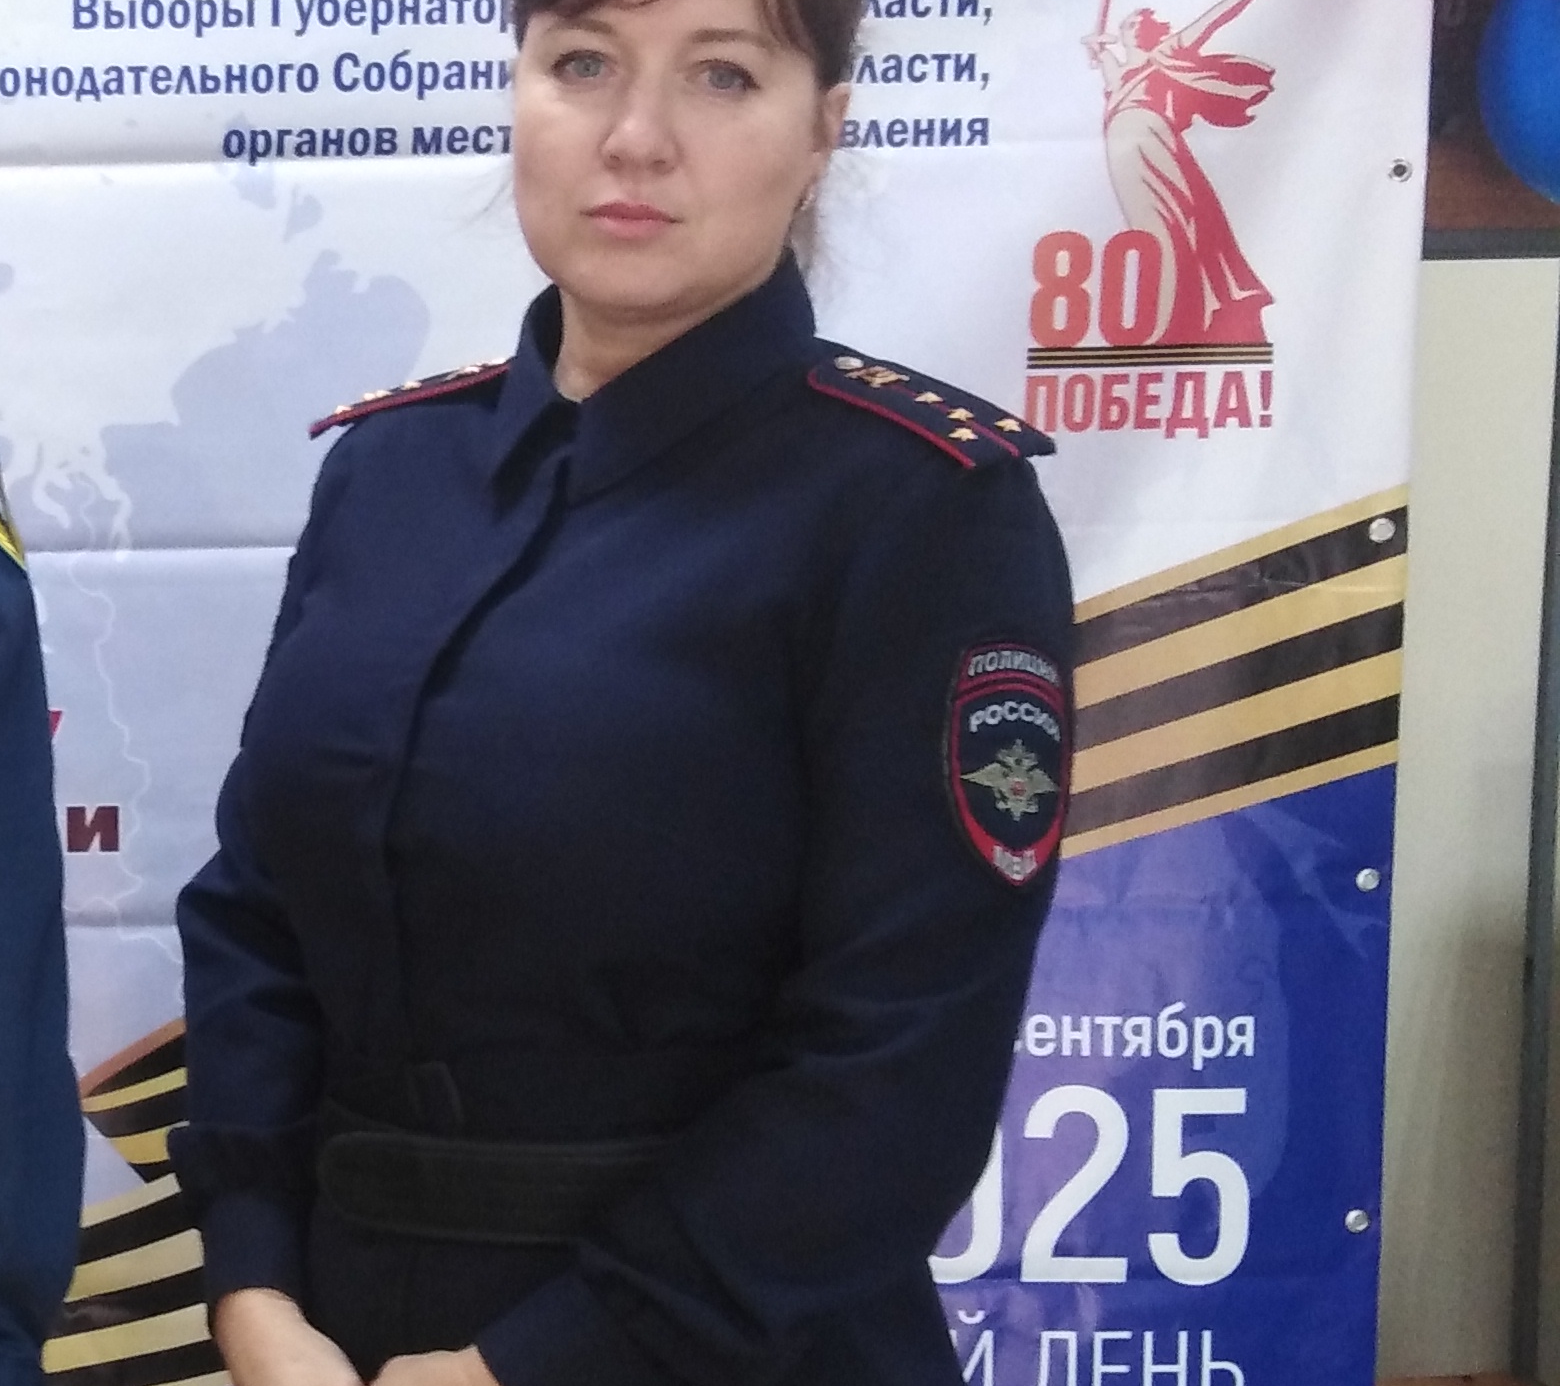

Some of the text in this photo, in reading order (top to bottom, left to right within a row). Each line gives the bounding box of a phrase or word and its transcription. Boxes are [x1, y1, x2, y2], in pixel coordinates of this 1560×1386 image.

[222, 127, 399, 166] органов
[411, 125, 513, 156] мест
[1029, 228, 1163, 346] 80
[1025, 369, 1274, 440] ПОБЕДА!
[1014, 1001, 1257, 1071] ентября
